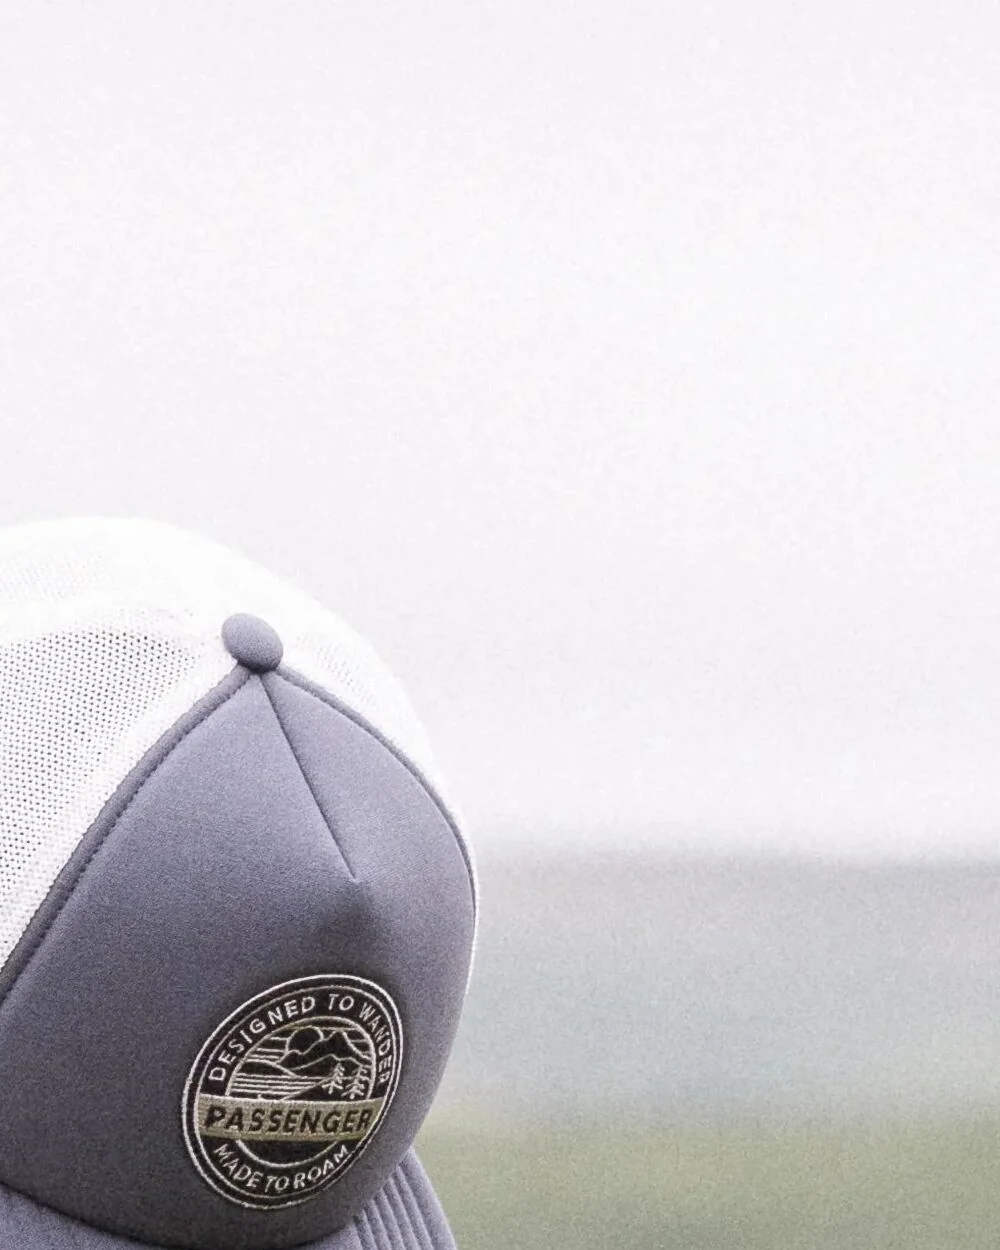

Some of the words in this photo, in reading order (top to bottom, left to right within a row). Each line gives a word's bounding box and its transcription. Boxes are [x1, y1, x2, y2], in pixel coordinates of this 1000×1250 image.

[208, 996, 316, 1081] DESIGNED
[328, 993, 355, 1012] TO
[358, 1001, 394, 1084] WANDER
[204, 1104, 374, 1135] PASSENGER
[213, 1143, 262, 1188] MADE
[265, 1175, 290, 1193] TO
[293, 1144, 349, 1189] ROAM
